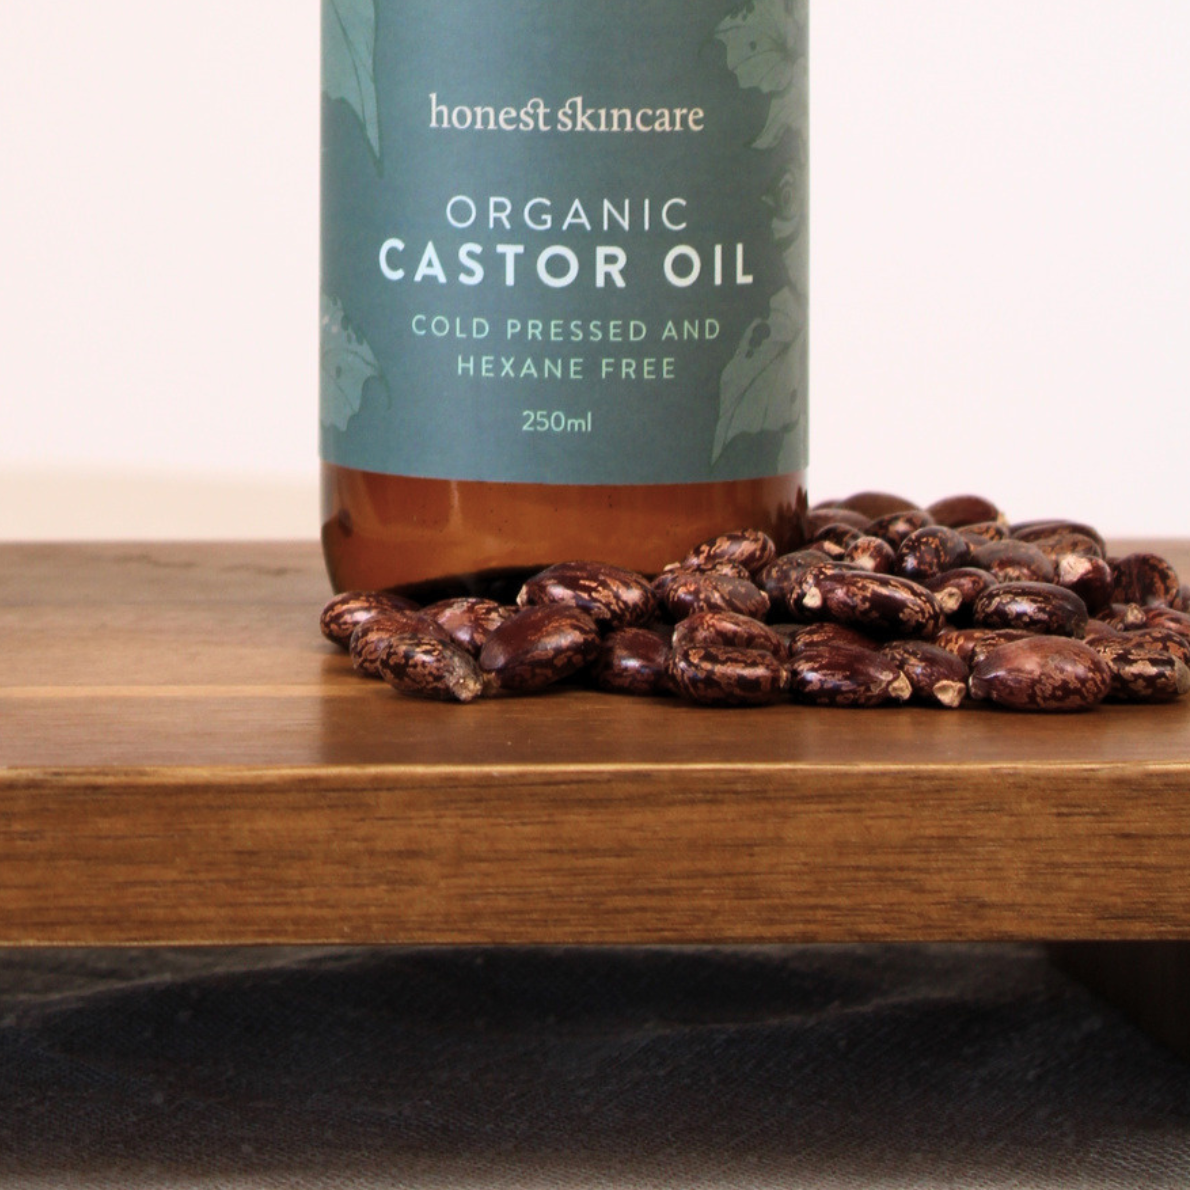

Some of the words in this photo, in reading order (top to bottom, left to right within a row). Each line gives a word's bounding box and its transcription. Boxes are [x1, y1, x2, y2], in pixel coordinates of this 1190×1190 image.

[428, 92, 551, 132] honest
[556, 96, 705, 132] skincare
[445, 194, 688, 232] ORGANIC
[378, 237, 628, 289] CASTOR
[663, 242, 754, 288] OIL
[411, 314, 490, 340] COLD
[506, 318, 647, 342] PRESSED
[661, 317, 721, 341] AND
[457, 354, 584, 380] HEXANE
[601, 357, 677, 380] FREE
[521, 410, 592, 433] 250ml
